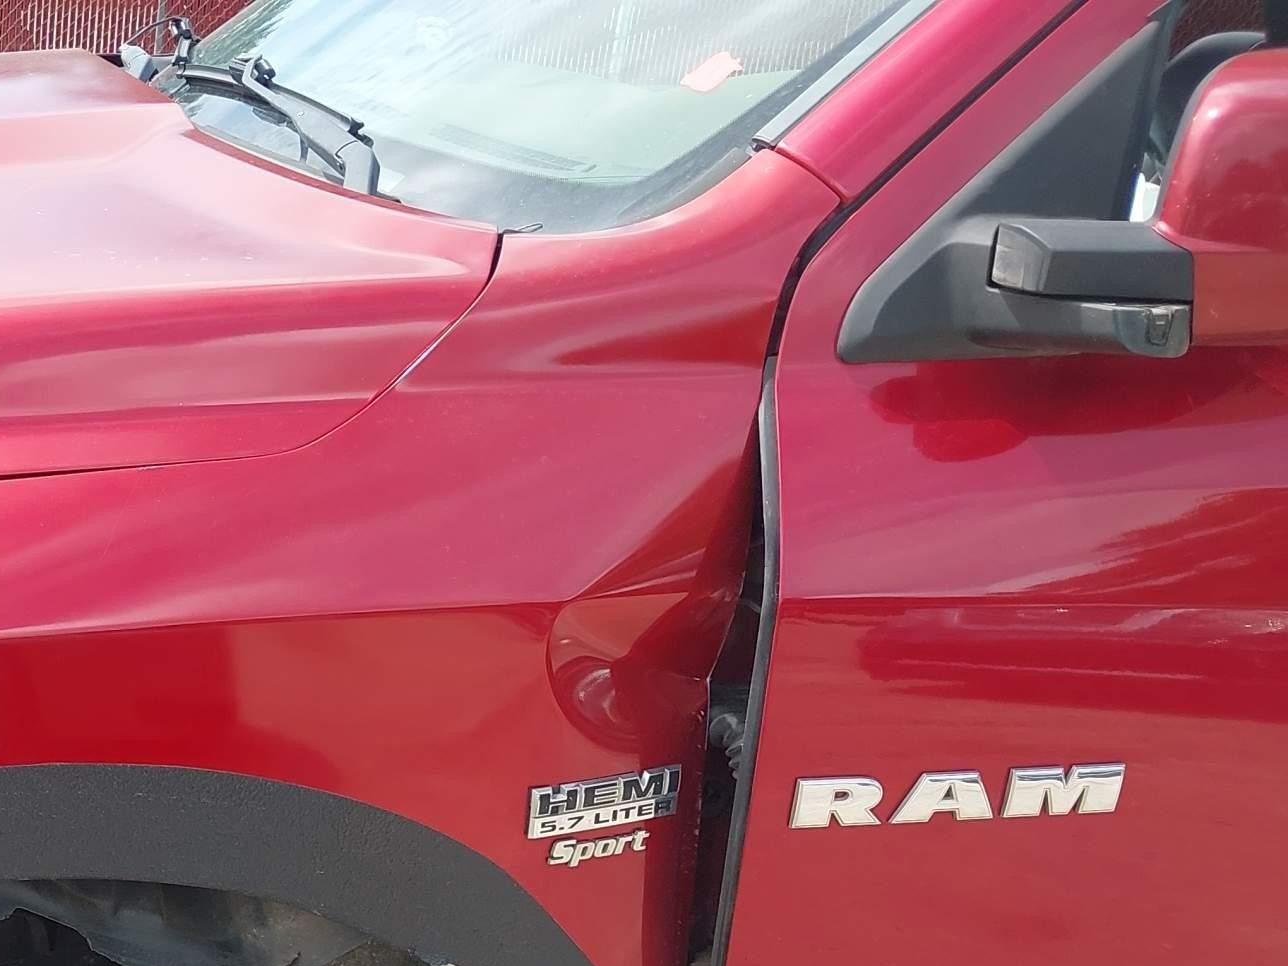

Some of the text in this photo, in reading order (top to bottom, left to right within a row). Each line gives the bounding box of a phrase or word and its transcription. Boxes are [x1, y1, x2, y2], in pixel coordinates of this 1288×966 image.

[536, 764, 681, 817] HEMI
[789, 762, 1126, 829] RAM
[539, 799, 674, 835] 5.7 LITER
[547, 829, 650, 867] Sport
